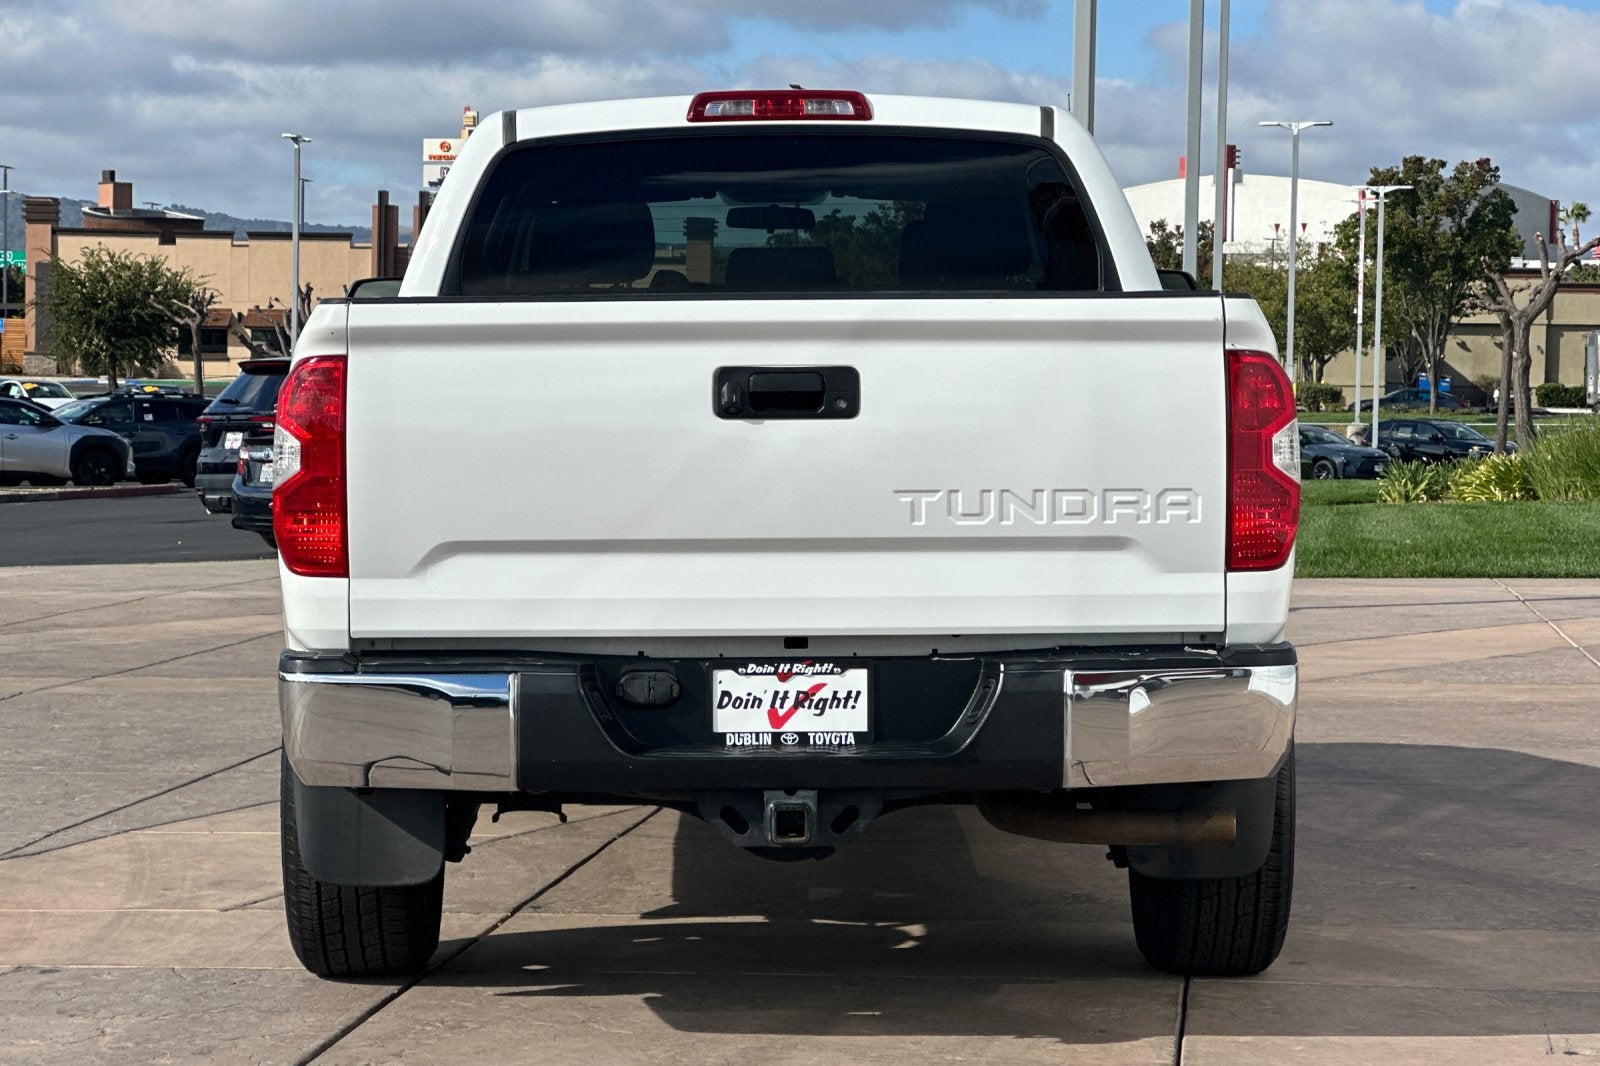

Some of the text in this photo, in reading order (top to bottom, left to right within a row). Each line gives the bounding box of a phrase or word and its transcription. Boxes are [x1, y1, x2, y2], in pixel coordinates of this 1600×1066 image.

[893, 487, 1202, 526] TUNDRA
[746, 663, 834, 676] Doin' It Right!
[717, 690, 862, 717] Doin' It Right!
[726, 732, 856, 746] DUBLIN TOYOTA
